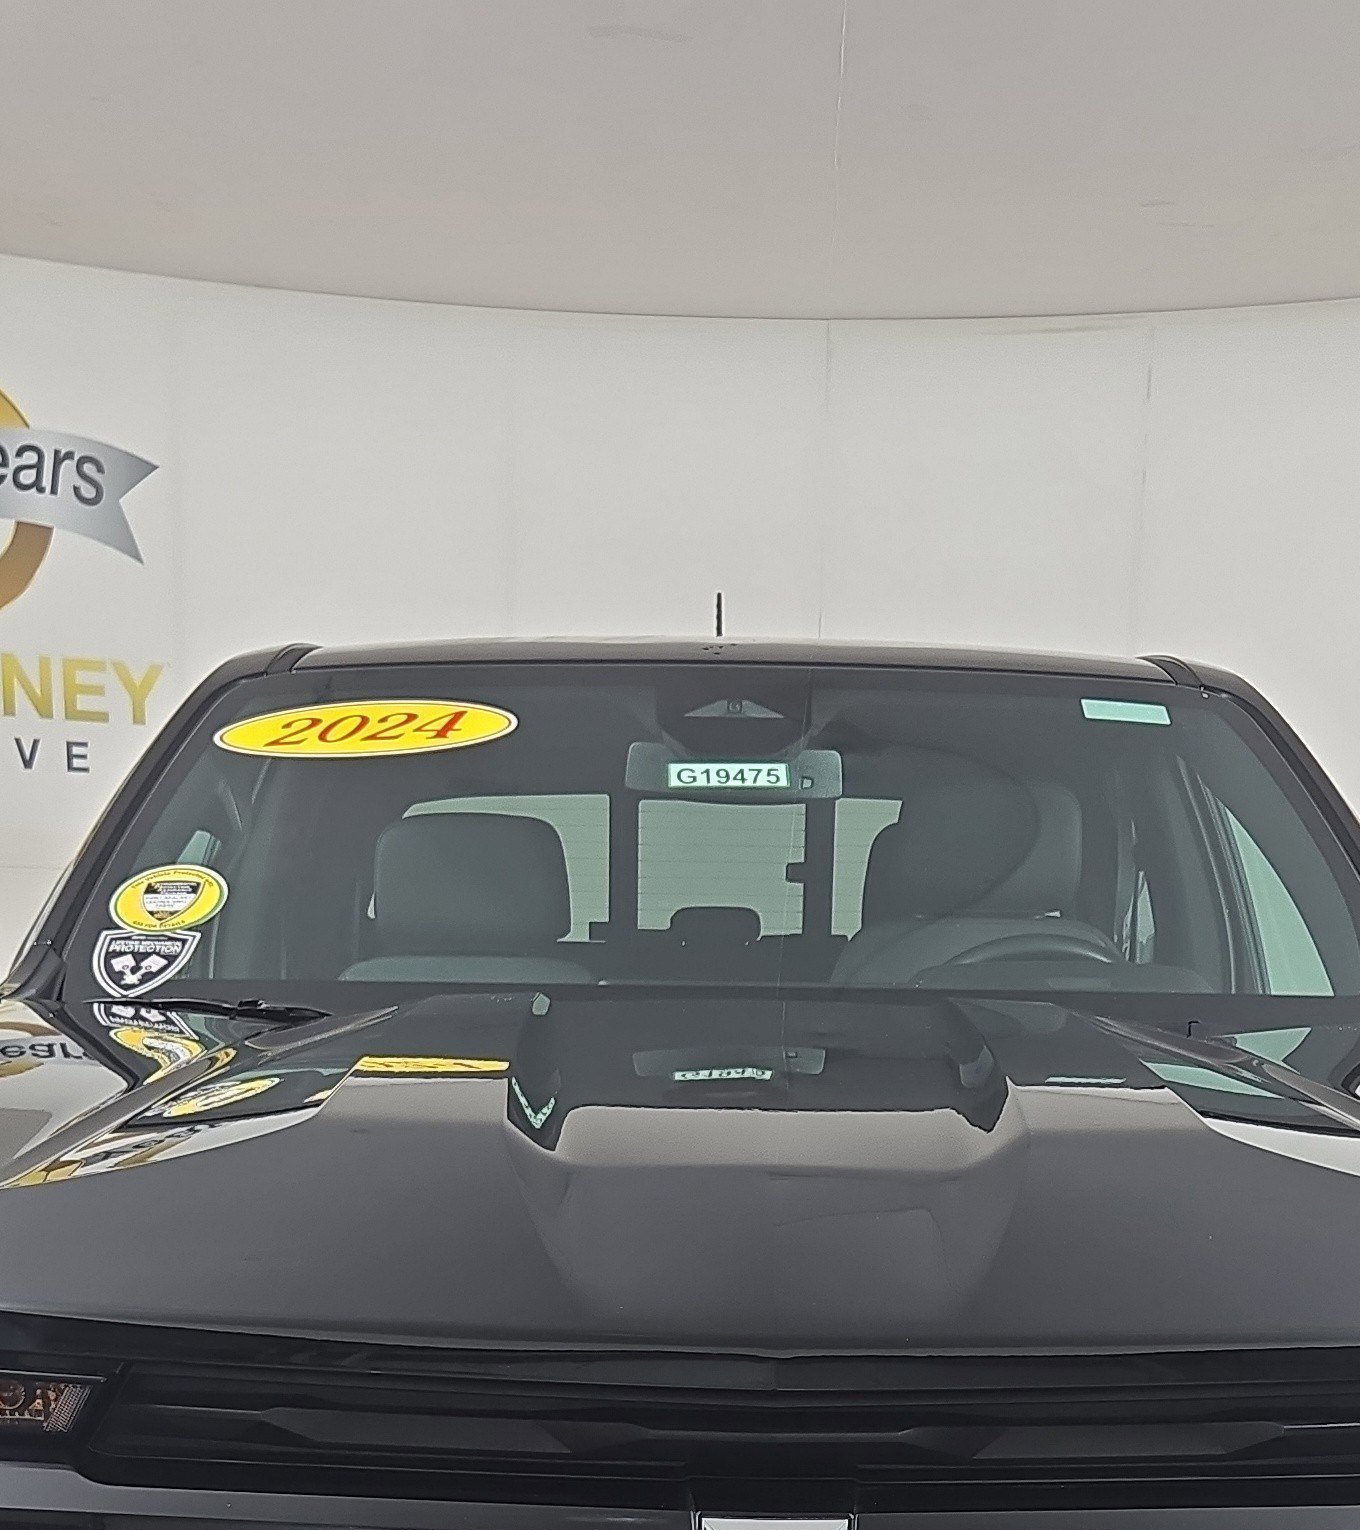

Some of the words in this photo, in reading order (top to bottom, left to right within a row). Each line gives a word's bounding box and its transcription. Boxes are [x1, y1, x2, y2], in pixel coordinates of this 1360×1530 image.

[263, 710, 468, 747] 2024
[676, 767, 781, 785] G19475
[107, 943, 181, 955] PROTECTION
